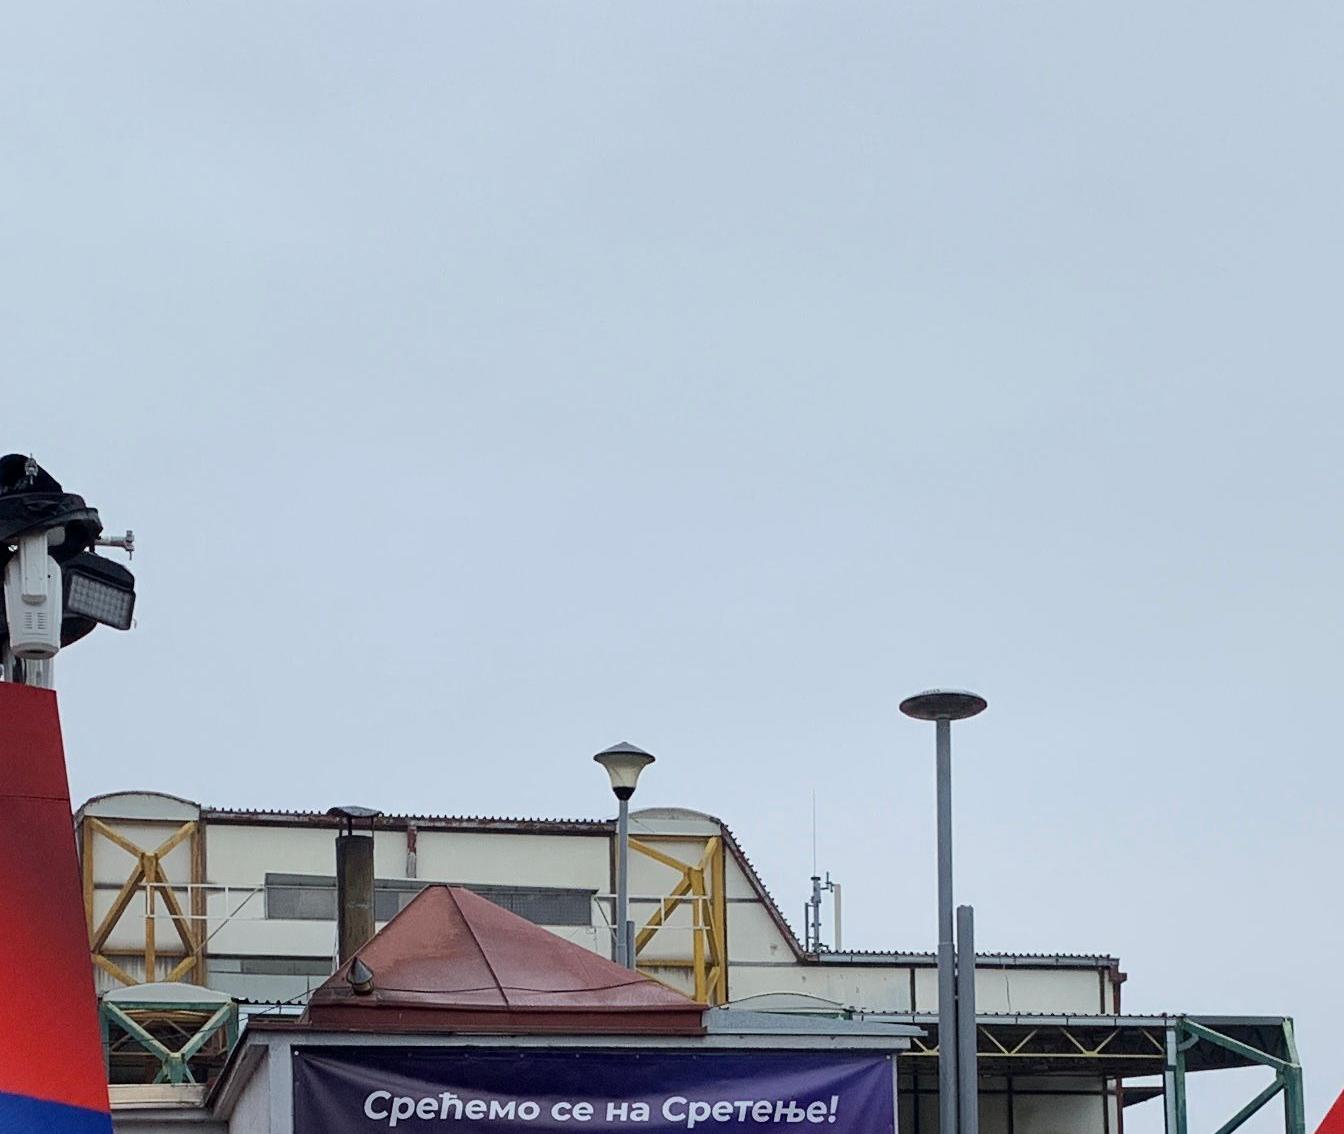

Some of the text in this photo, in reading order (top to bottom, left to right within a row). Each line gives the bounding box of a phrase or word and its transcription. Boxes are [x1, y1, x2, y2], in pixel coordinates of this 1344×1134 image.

[363, 1090, 840, 1129] Срећемо се на Сретење!
